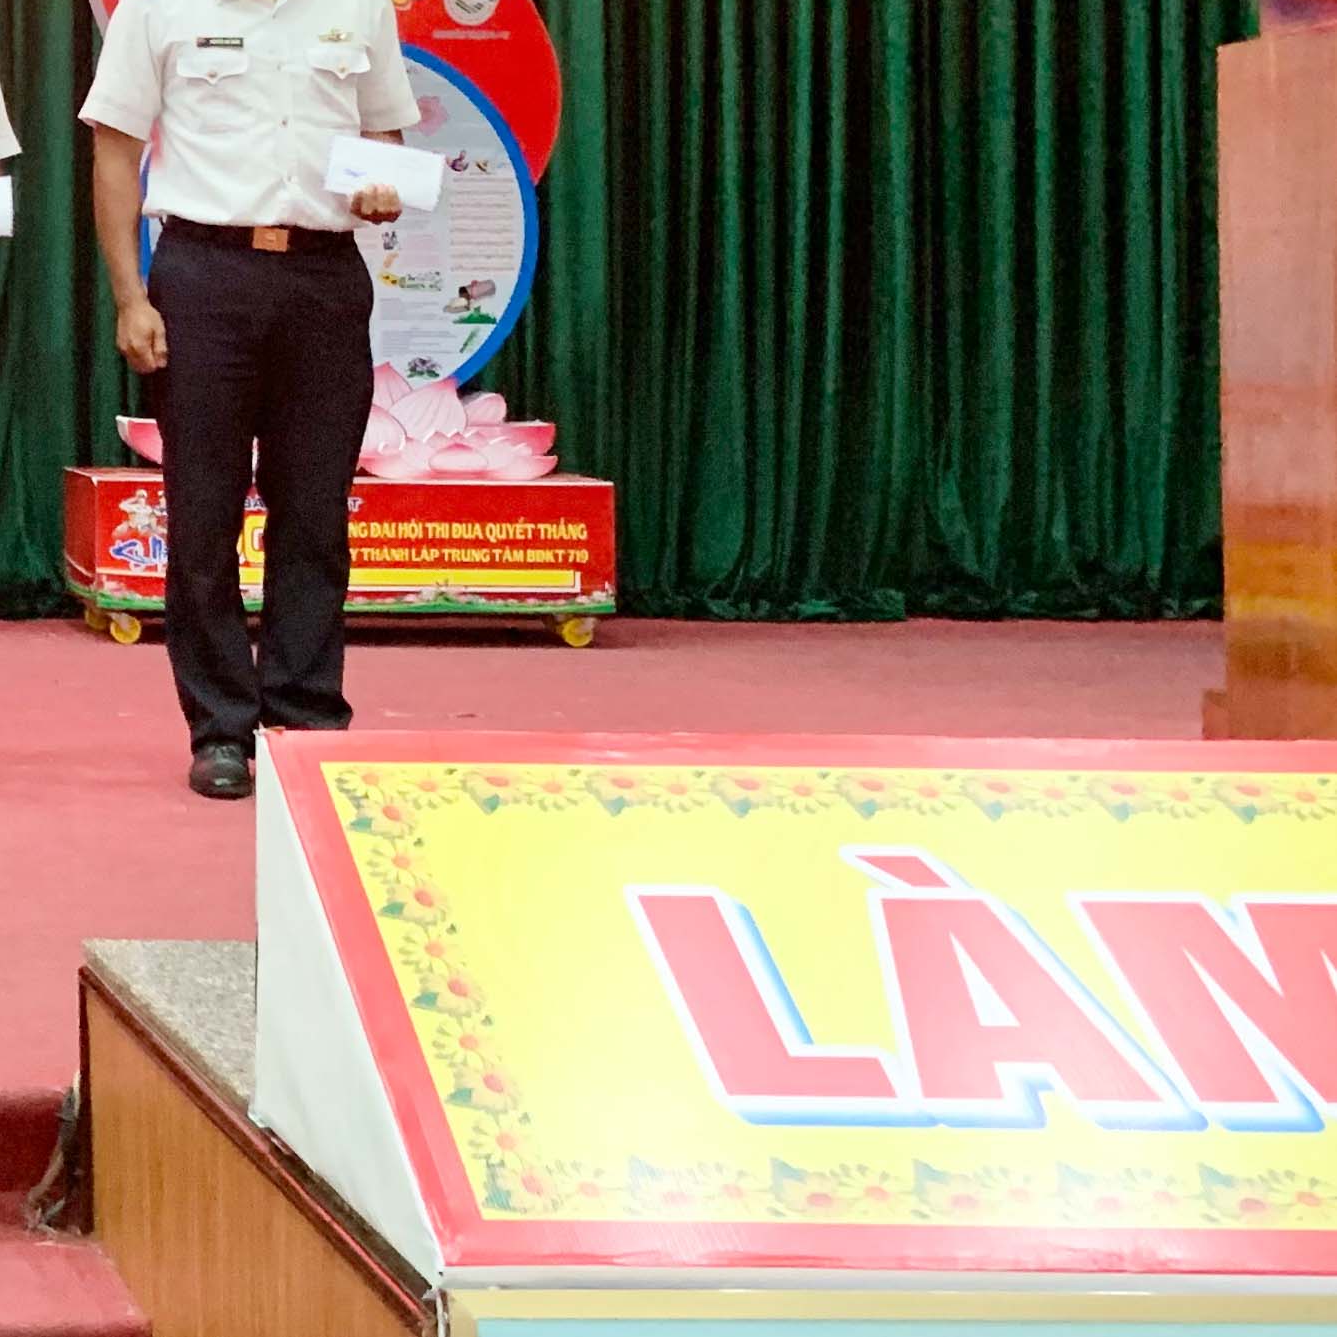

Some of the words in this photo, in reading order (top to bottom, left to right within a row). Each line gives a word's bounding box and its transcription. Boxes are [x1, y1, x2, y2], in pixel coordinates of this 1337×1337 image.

[424, 522, 450, 539] THI
[451, 522, 484, 539] ĐUA
[485, 516, 536, 542] QUYẾT
[626, 844, 1337, 1130] LÀM
